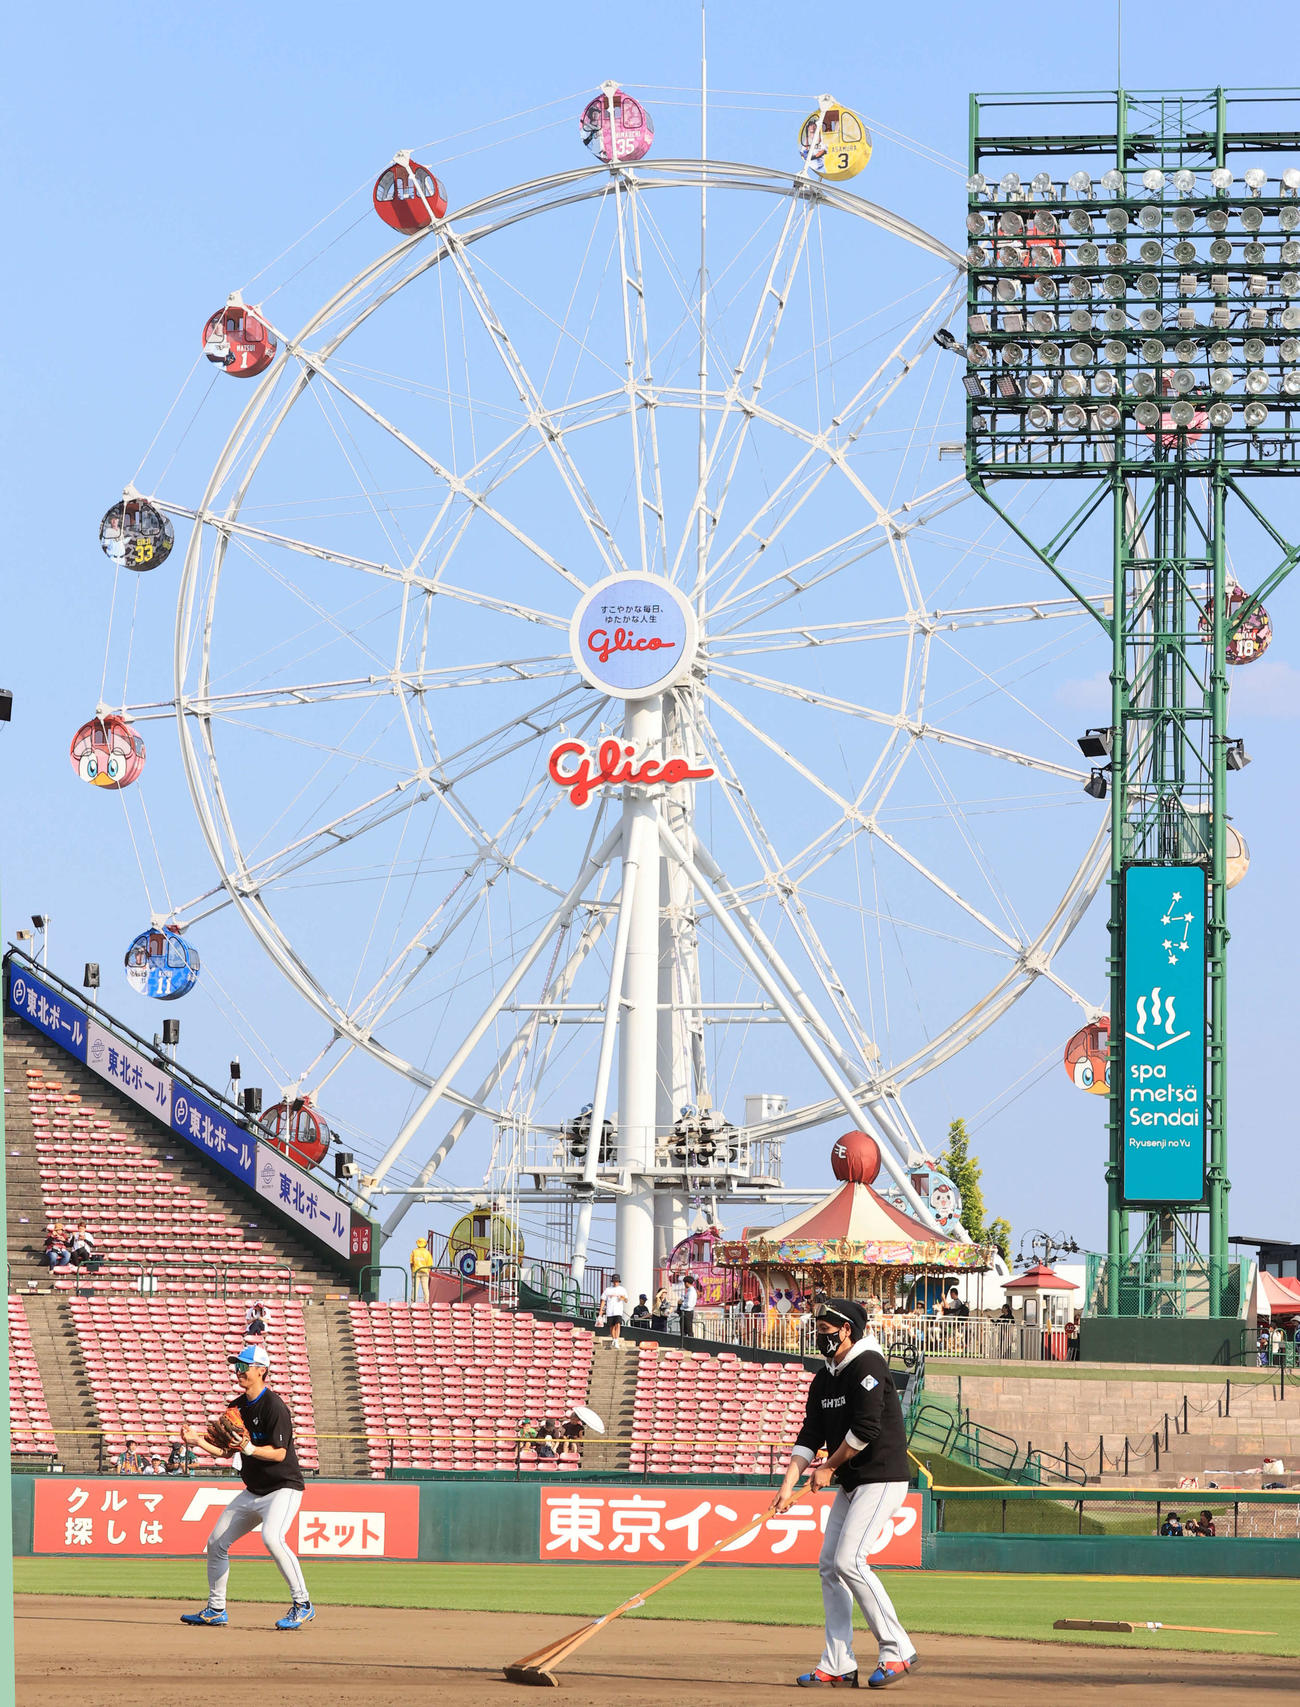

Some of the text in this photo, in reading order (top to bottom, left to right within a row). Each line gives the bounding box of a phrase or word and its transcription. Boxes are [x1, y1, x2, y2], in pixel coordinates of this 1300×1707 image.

[616, 138, 635, 155] 35
[837, 152, 849, 169] 3
[236, 344, 256, 352] MATSUI
[240, 351, 248, 369] 1
[135, 544, 153, 563] 33
[601, 604, 664, 614] すこやかな毎日、
[605, 615, 657, 624] ゆたかな人生
[587, 627, 675, 663] Glico
[1237, 639, 1254, 657] 18
[548, 739, 714, 806] Glico
[156, 977, 171, 995] 11
[26, 988, 83, 1046] 東北ポール
[107, 1047, 167, 1106] 東北ポール
[1130, 1064, 1167, 1084] spa
[1130, 1083, 1197, 1102] metsä
[1129, 1107, 1199, 1127] Sendai
[189, 1106, 252, 1171] 東北ポール
[1129, 1137, 1167, 1149] Ryusenji
[279, 1172, 345, 1238] 東北ポール
[704, 1284, 721, 1302] 14
[67, 1486, 164, 1513] クルマ
[64, 1517, 164, 1546] 探しは
[303, 1517, 381, 1549] ネット
[546, 1493, 917, 1555] 東京インテア
